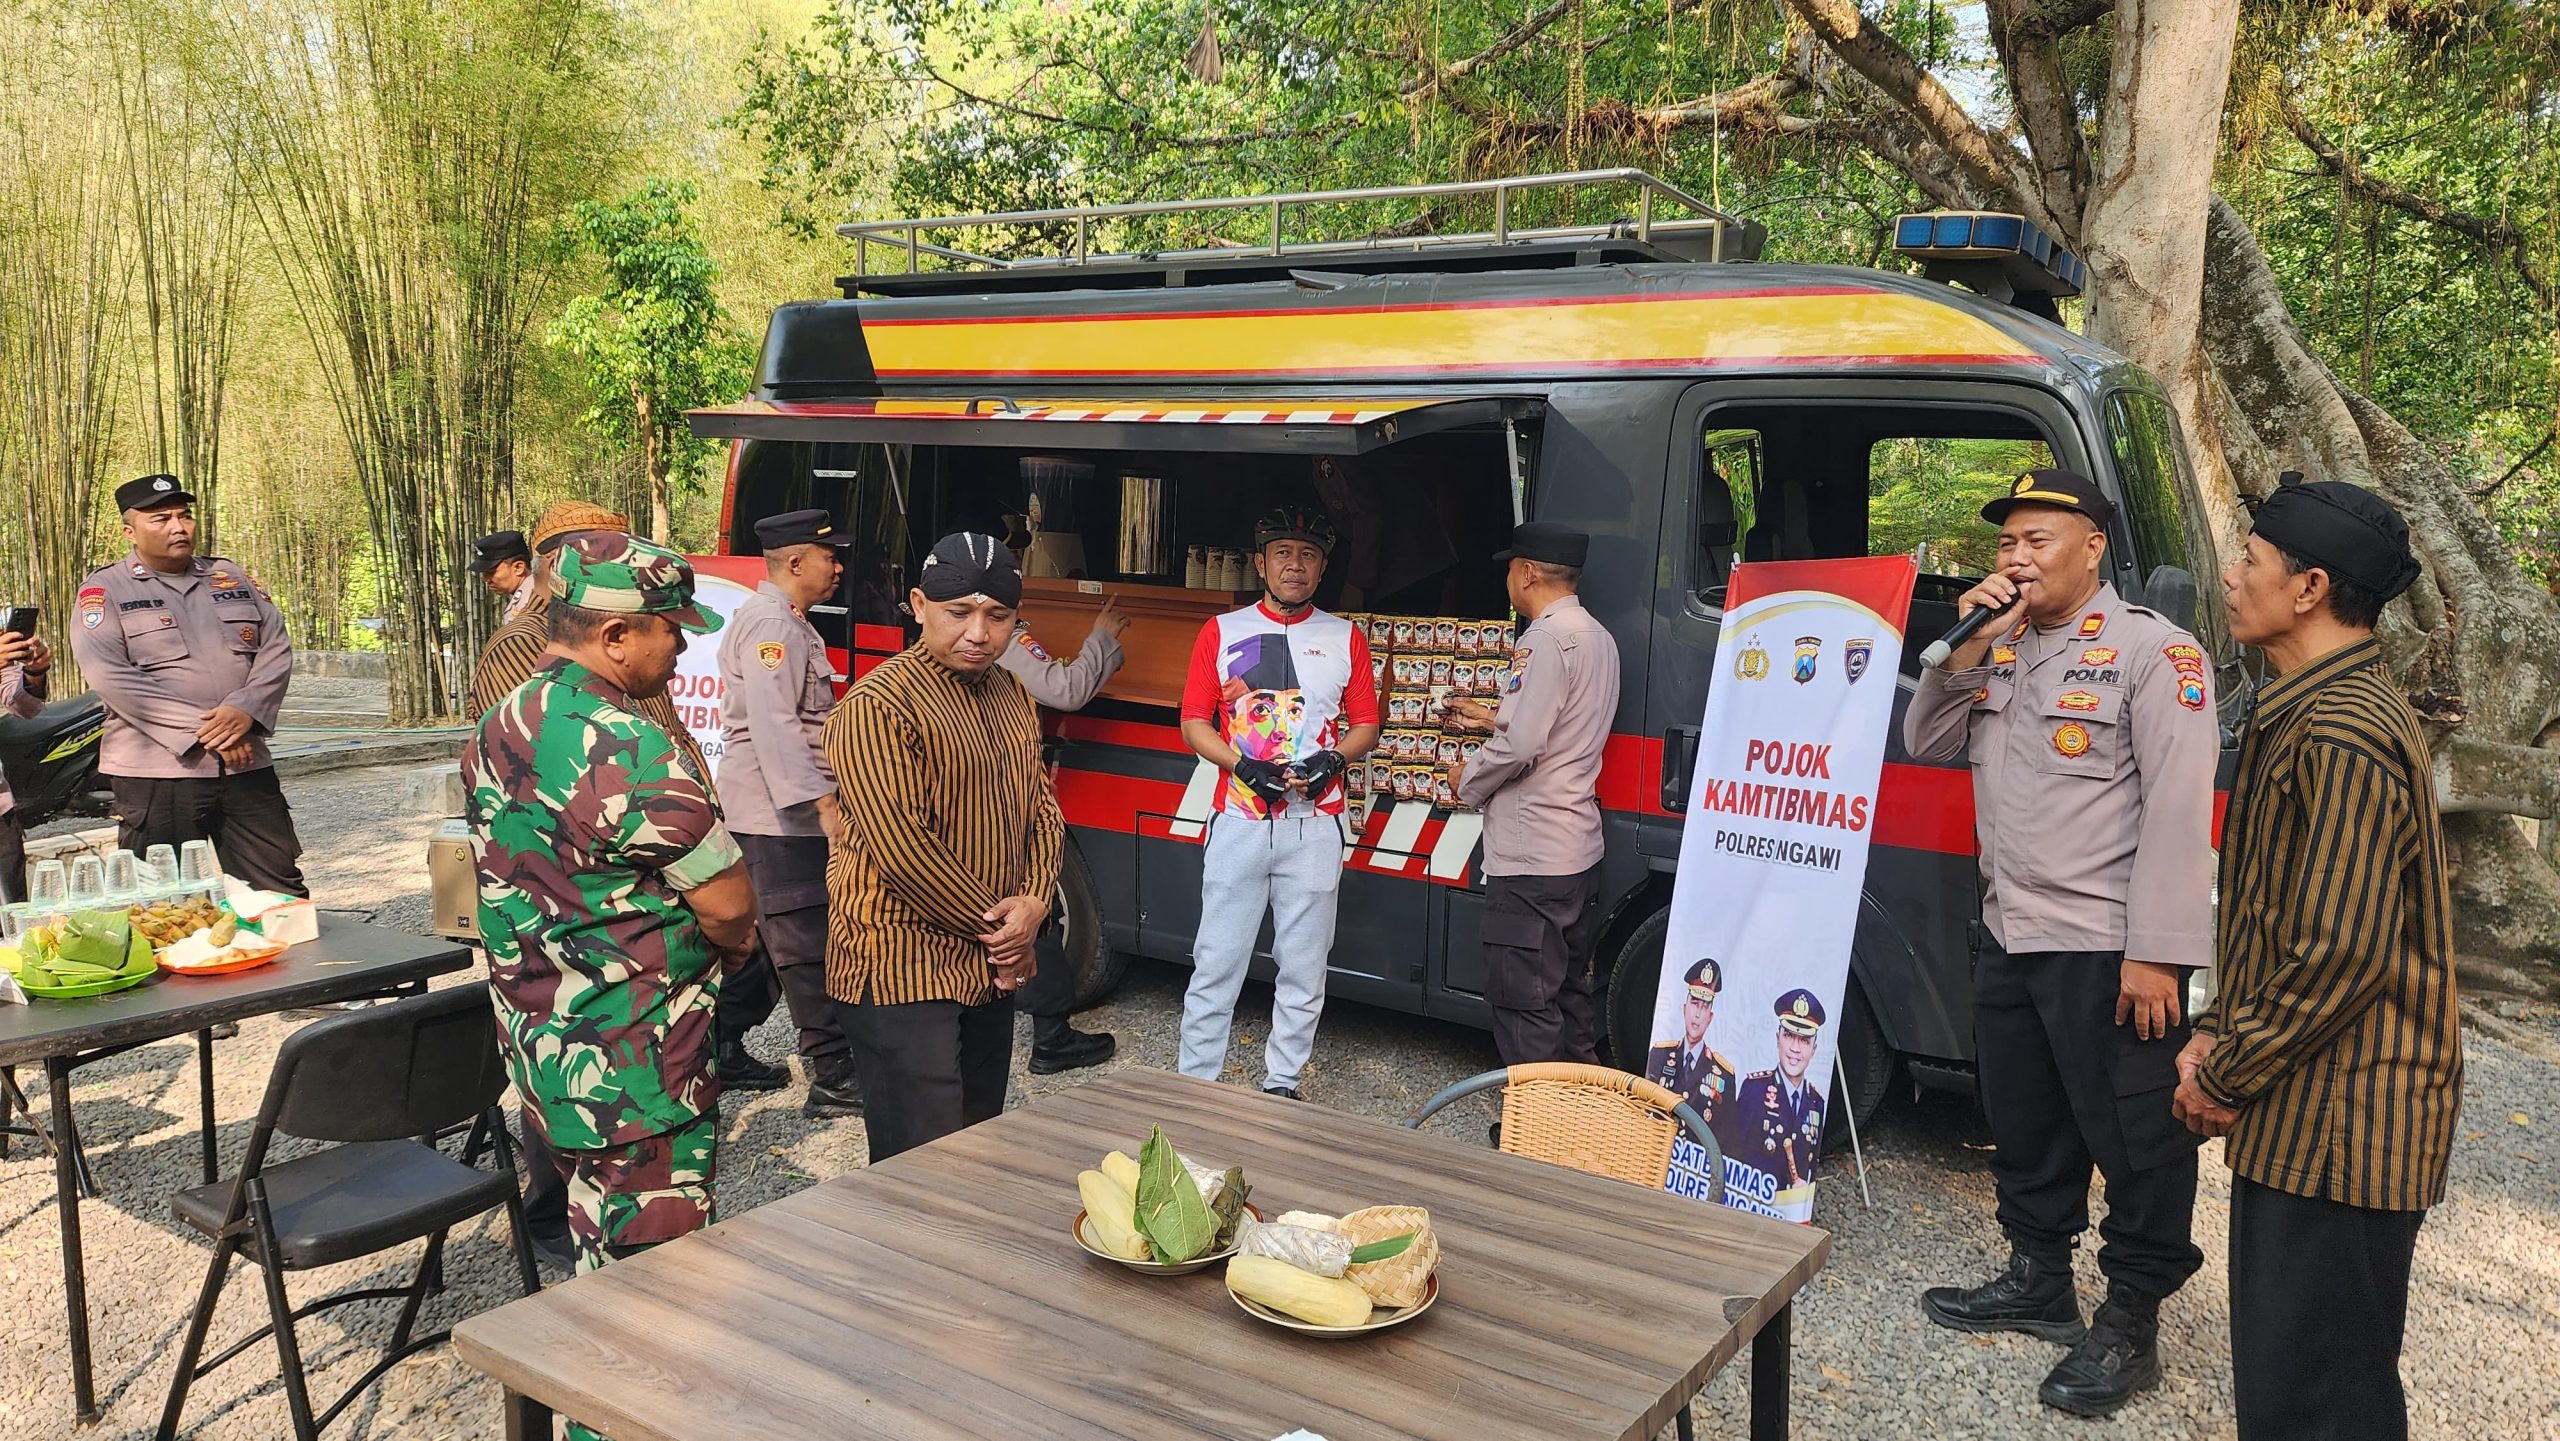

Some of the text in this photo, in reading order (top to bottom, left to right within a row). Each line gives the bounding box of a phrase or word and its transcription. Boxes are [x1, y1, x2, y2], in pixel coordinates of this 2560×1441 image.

[2063, 668, 2120, 683] POLRI
[1745, 739, 1832, 780] POJOK
[1703, 778, 1868, 832] KAMTIBMAS
[1714, 829, 1841, 871] POLRES NGAWI
[1671, 1138, 1776, 1201] SATBNMAS
